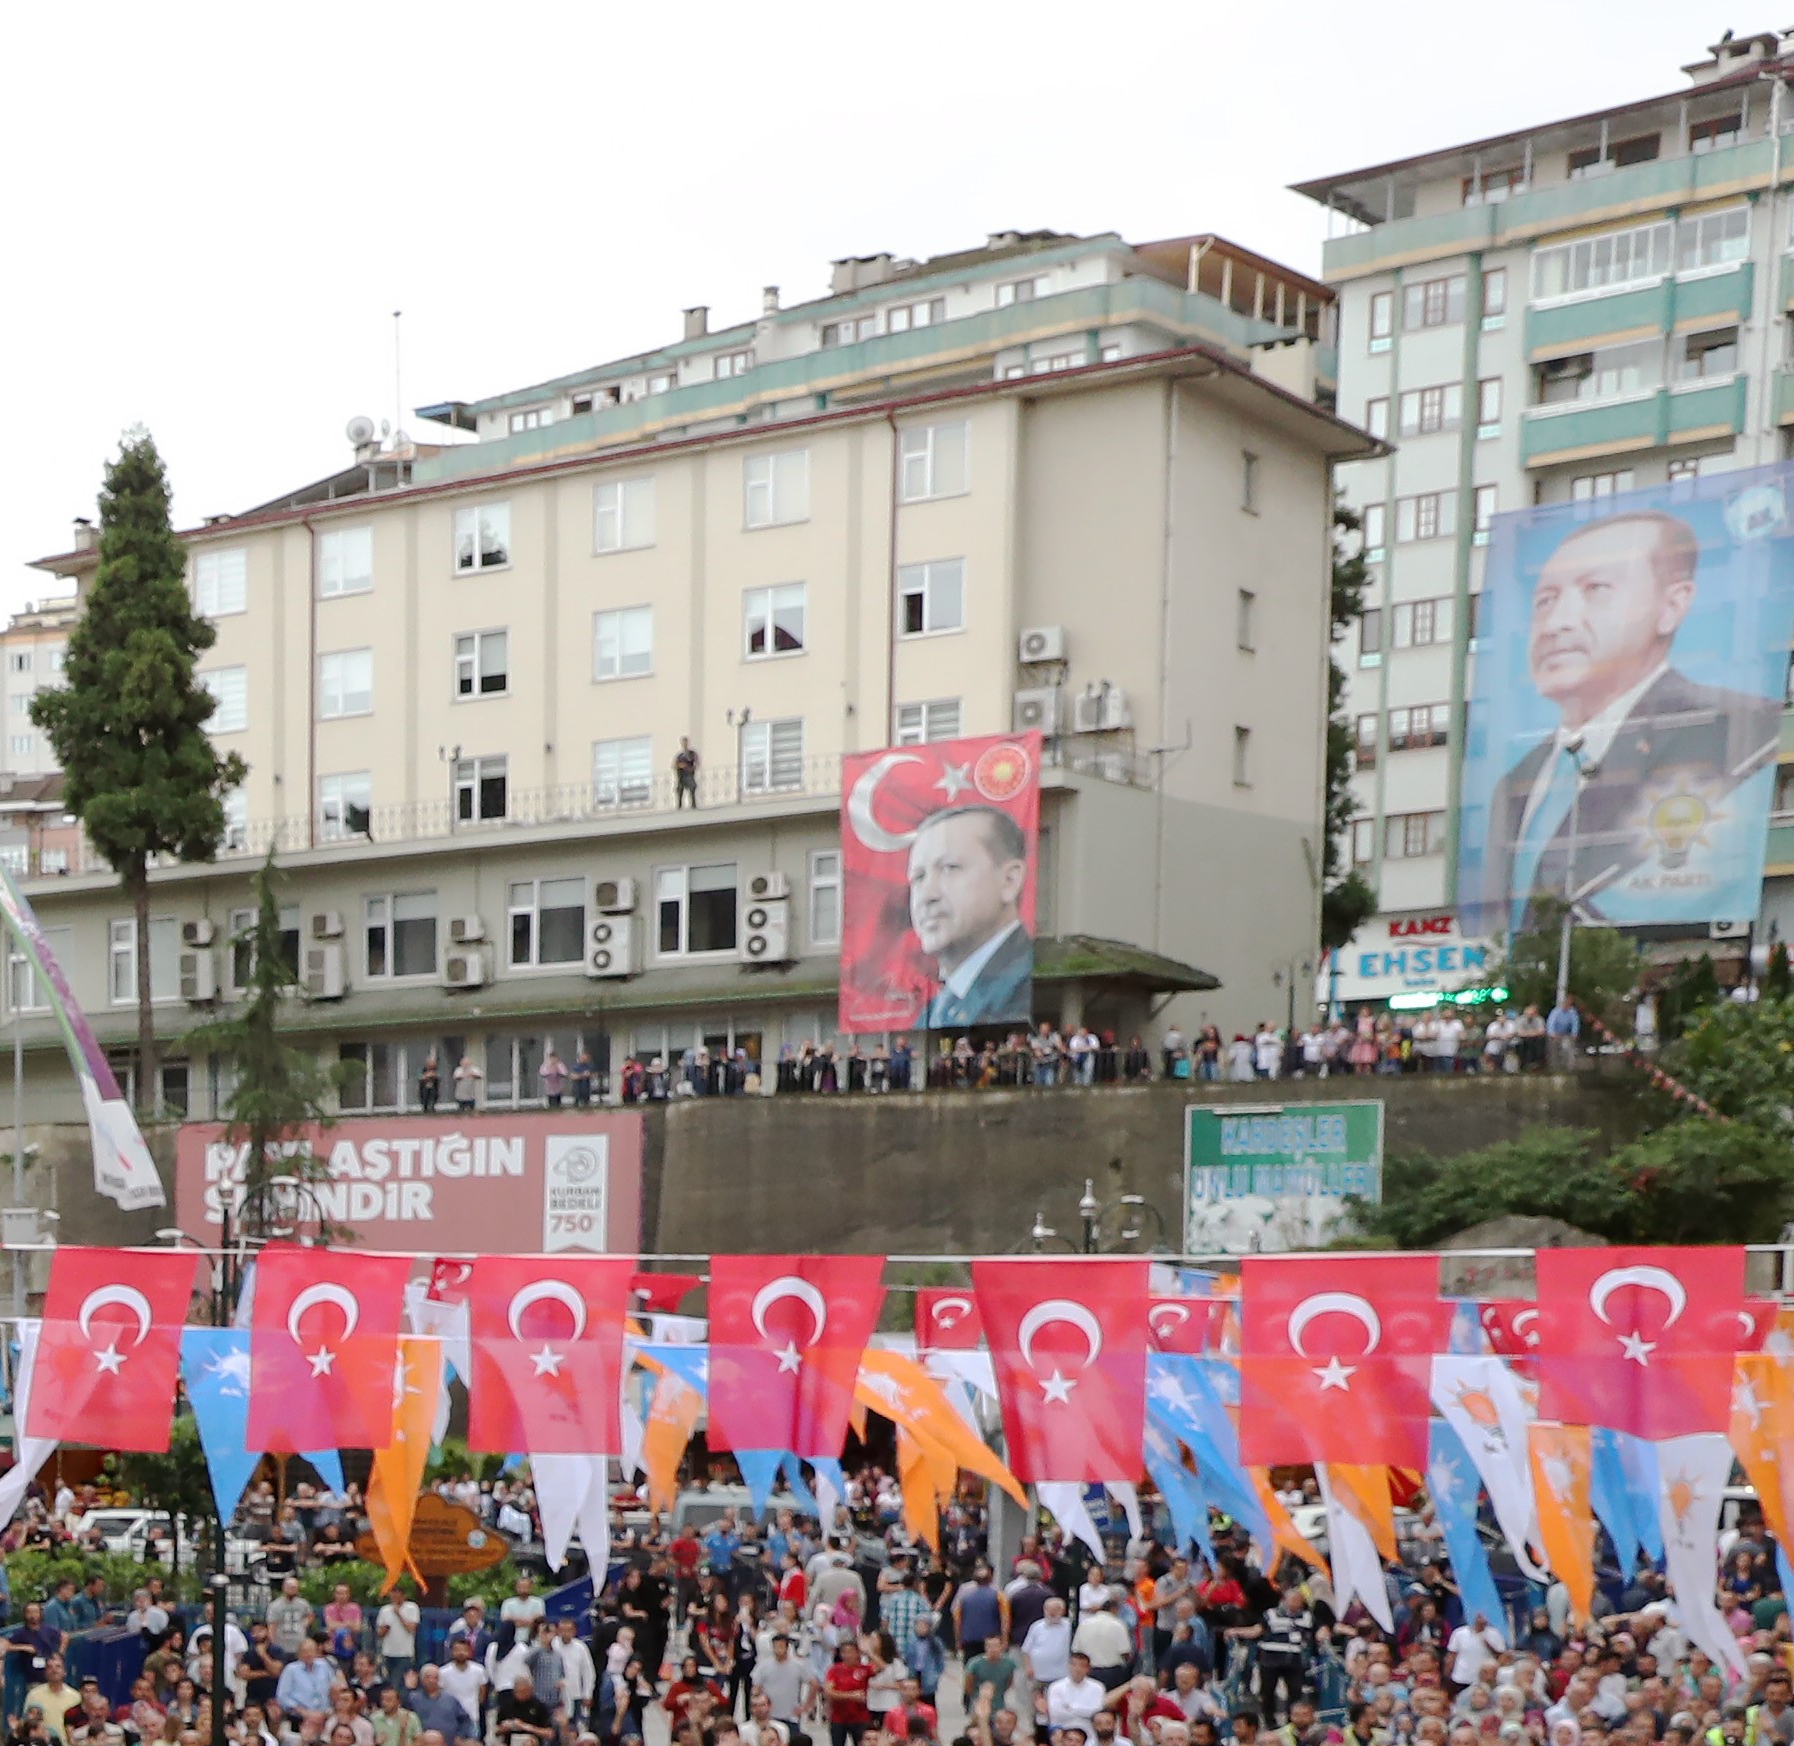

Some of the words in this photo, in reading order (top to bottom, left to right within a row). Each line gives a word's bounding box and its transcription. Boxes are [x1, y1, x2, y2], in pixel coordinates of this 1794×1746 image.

[1389, 915, 1454, 938] KANZ
[1359, 946, 1487, 978] EHSEN
[550, 1214, 593, 1233] 750
